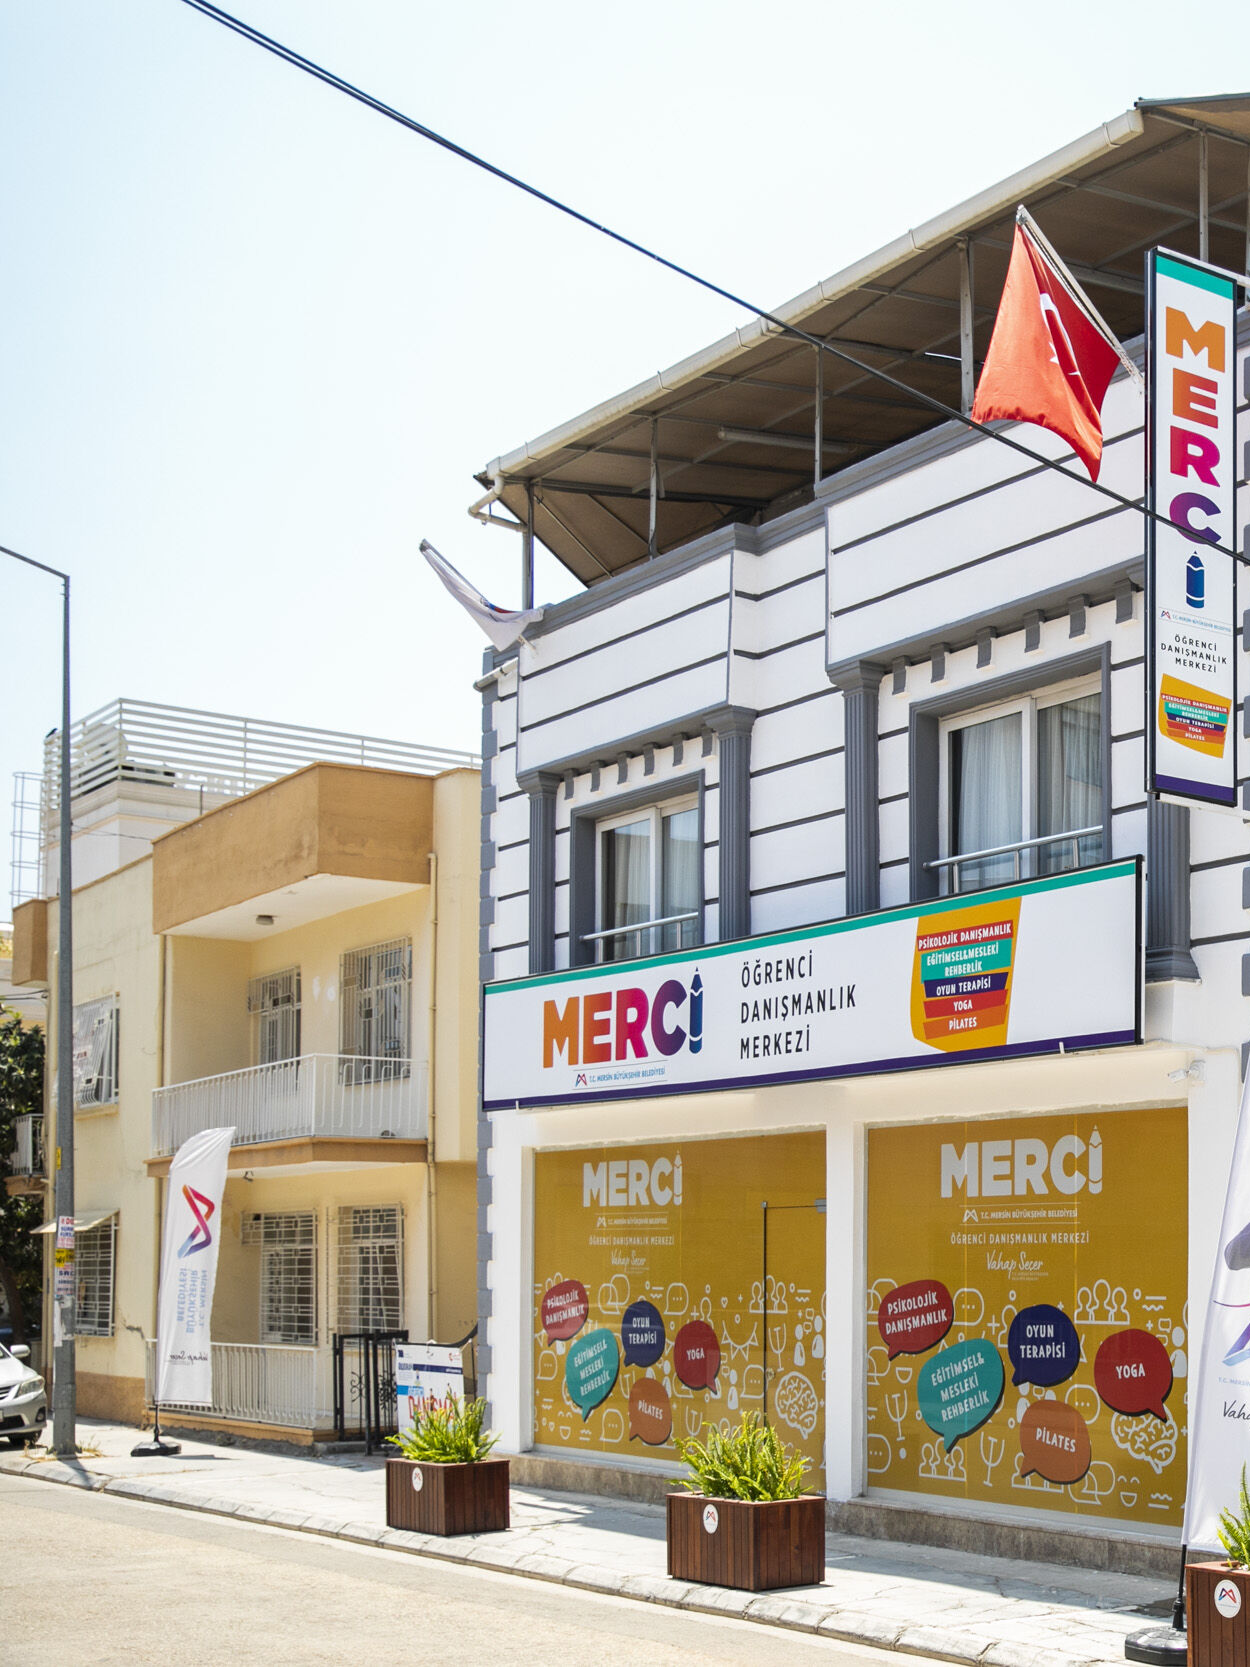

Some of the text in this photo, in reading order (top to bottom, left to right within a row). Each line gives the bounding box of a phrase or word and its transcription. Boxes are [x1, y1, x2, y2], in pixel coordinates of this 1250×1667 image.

[1174, 634, 1217, 651] ÖĞRENCİ
[1161, 643, 1227, 664] DANIŞMANLIK
[1175, 657, 1217, 673] MERKEZİ
[918, 923, 1011, 949] PSİKOLOJİK DANIŞMANLIK
[741, 949, 812, 988] ÖĞRENCİ
[945, 960, 982, 977] REHBERLİK
[936, 976, 991, 996] OYUN TERAPİSİ
[741, 984, 856, 1024] DANIŞMANLIK
[953, 1000, 973, 1012] YOGA
[949, 1017, 977, 1030] PİLATES
[740, 1024, 809, 1059] MERKEZİ
[951, 1231, 1089, 1245] ÖĞRENCİ DANIŞMANLIK MERKEZİ
[986, 1249, 1016, 1279] Vahap
[887, 1290, 938, 1315] PSİKOLOJİK
[632, 1317, 650, 1328] OYUN
[885, 1309, 947, 1335] DANIŞMANLIK
[1026, 1324, 1054, 1338] OYUN
[629, 1331, 657, 1344] TERAPİSİ
[686, 1347, 705, 1360] YOGA
[1020, 1341, 1066, 1358] TERAPİSİ
[1116, 1363, 1146, 1379] YOGA
[940, 1372, 979, 1402] MESLEKİ
[638, 1400, 663, 1420] PİLATES
[941, 1390, 990, 1422] REHBERLİK
[1036, 1427, 1077, 1453] PİLATES
